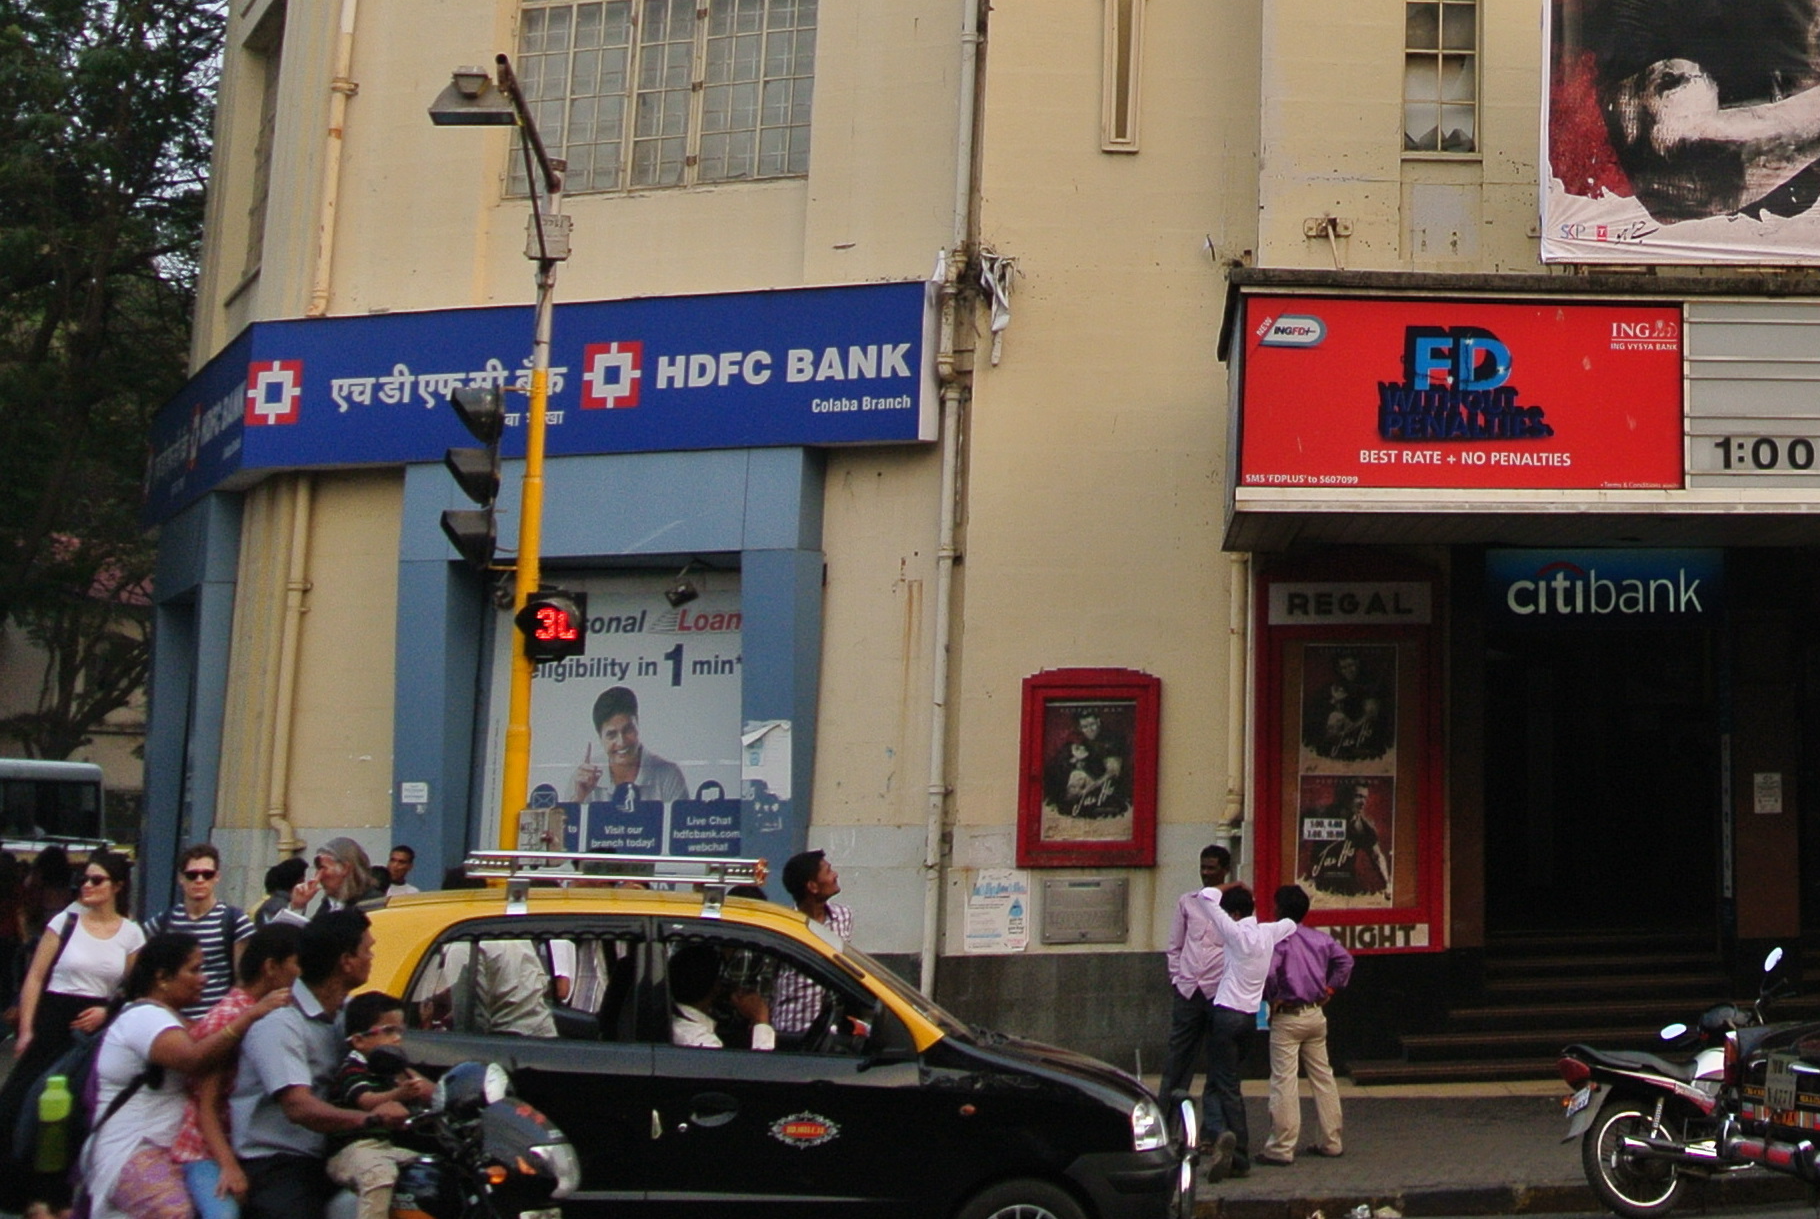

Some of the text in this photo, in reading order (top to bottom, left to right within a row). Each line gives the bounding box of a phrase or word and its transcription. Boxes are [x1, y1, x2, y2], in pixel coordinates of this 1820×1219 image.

[1611, 322, 1650, 338] ING
[1627, 343, 1654, 351] VYSYA
[1656, 343, 1678, 351] BANK
[656, 343, 912, 389] HDFC BANK
[1413, 336, 1513, 391] FD
[811, 394, 911, 413] Colaba Branch
[1359, 450, 1398, 464] BEST
[1402, 450, 1442, 465] RATE
[1461, 451, 1486, 466] NO
[1491, 452, 1571, 467] PENALTIES
[1714, 436, 1815, 471] 1:00
[1245, 474, 1265, 483] SMS
[1308, 475, 1317, 483] to
[1319, 475, 1358, 484] 5607099
[1507, 566, 1703, 615] citibank
[1286, 592, 1413, 616] REGAL
[677, 609, 742, 631] Loan
[637, 656, 657, 676] in
[664, 643, 684, 686] 1
[568, 825, 577, 833] to
[686, 815, 732, 826] Live Chat
[604, 825, 643, 835] Visit our
[591, 837, 655, 849] branch today!
[687, 842, 729, 852] webchat
[1330, 925, 1417, 949] NIGHT
